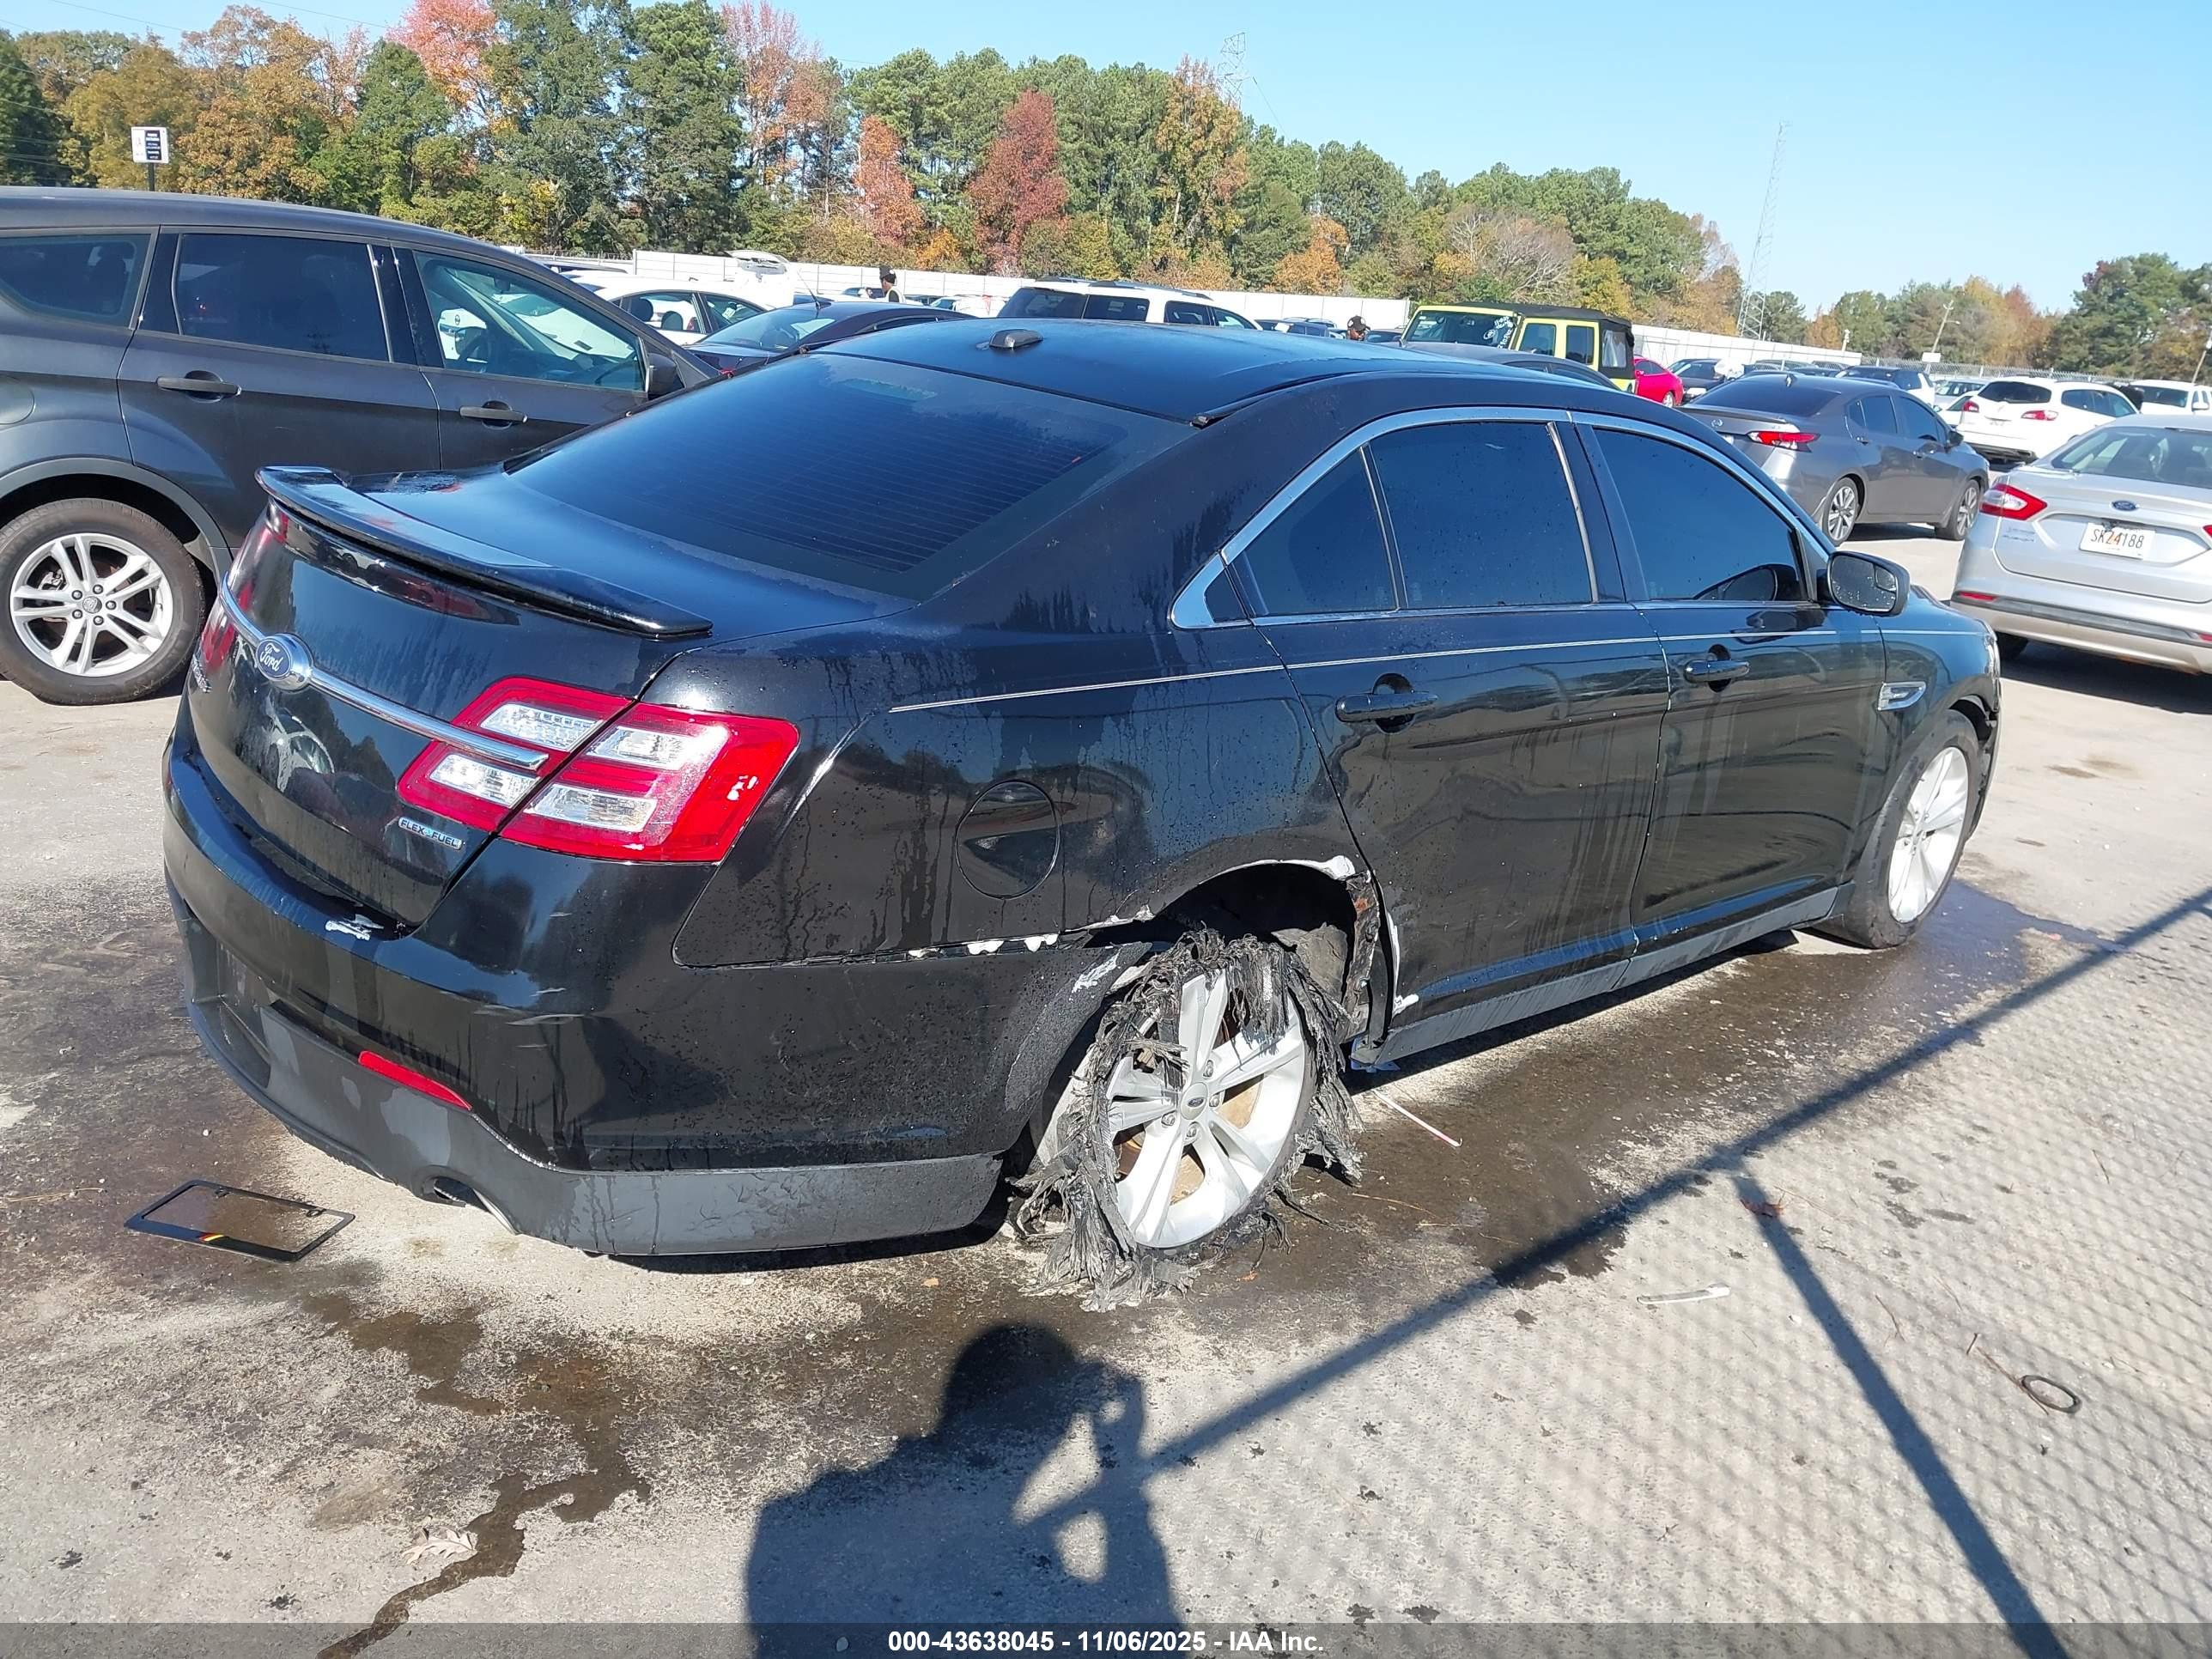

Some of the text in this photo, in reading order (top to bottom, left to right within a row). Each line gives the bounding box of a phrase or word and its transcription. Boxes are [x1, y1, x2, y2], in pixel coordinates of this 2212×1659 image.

[259, 642, 284, 672] Ford
[401, 819, 457, 847] FLEX FUEL
